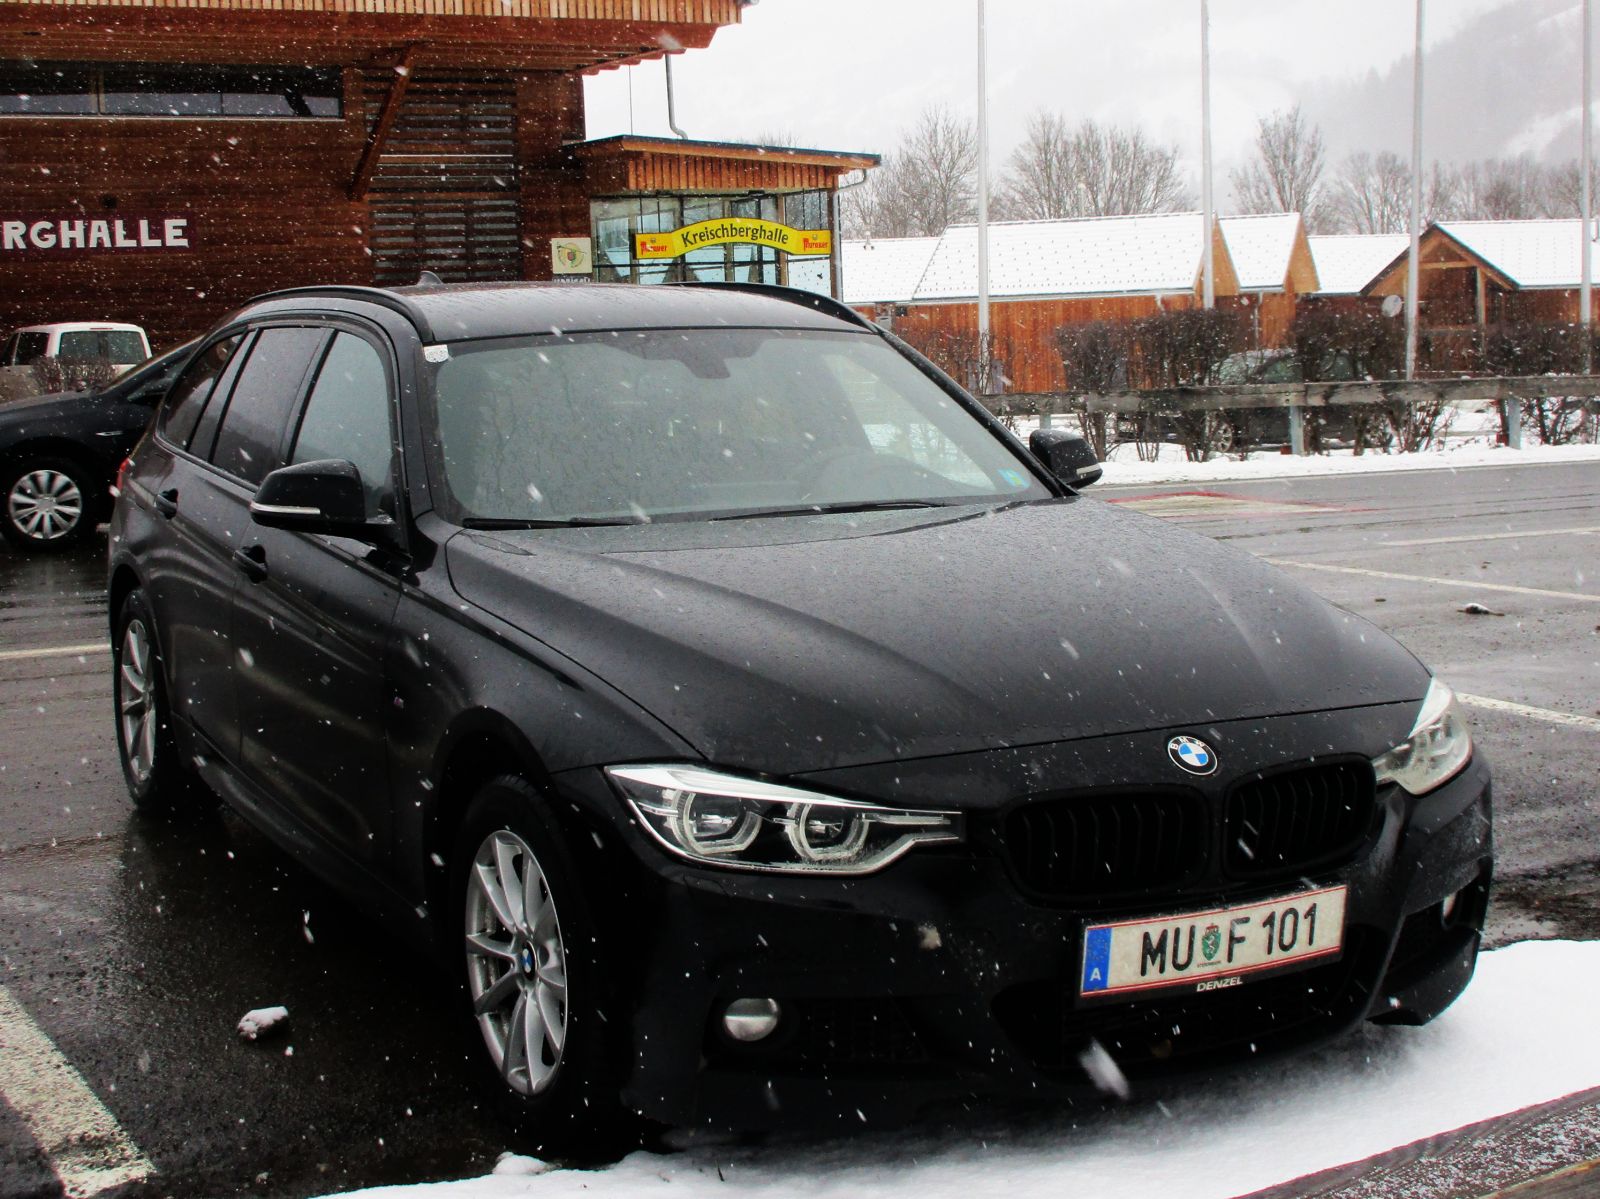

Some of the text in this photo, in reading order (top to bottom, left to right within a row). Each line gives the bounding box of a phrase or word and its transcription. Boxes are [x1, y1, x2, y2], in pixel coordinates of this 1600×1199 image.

[2, 219, 189, 249] RGHALLE
[681, 223, 789, 247] Kreischberghalle
[1170, 736, 1205, 750] BMW
[1140, 902, 1317, 977] MU F 101
[1090, 967, 1101, 981] A
[1196, 976, 1243, 992] DENZEL
